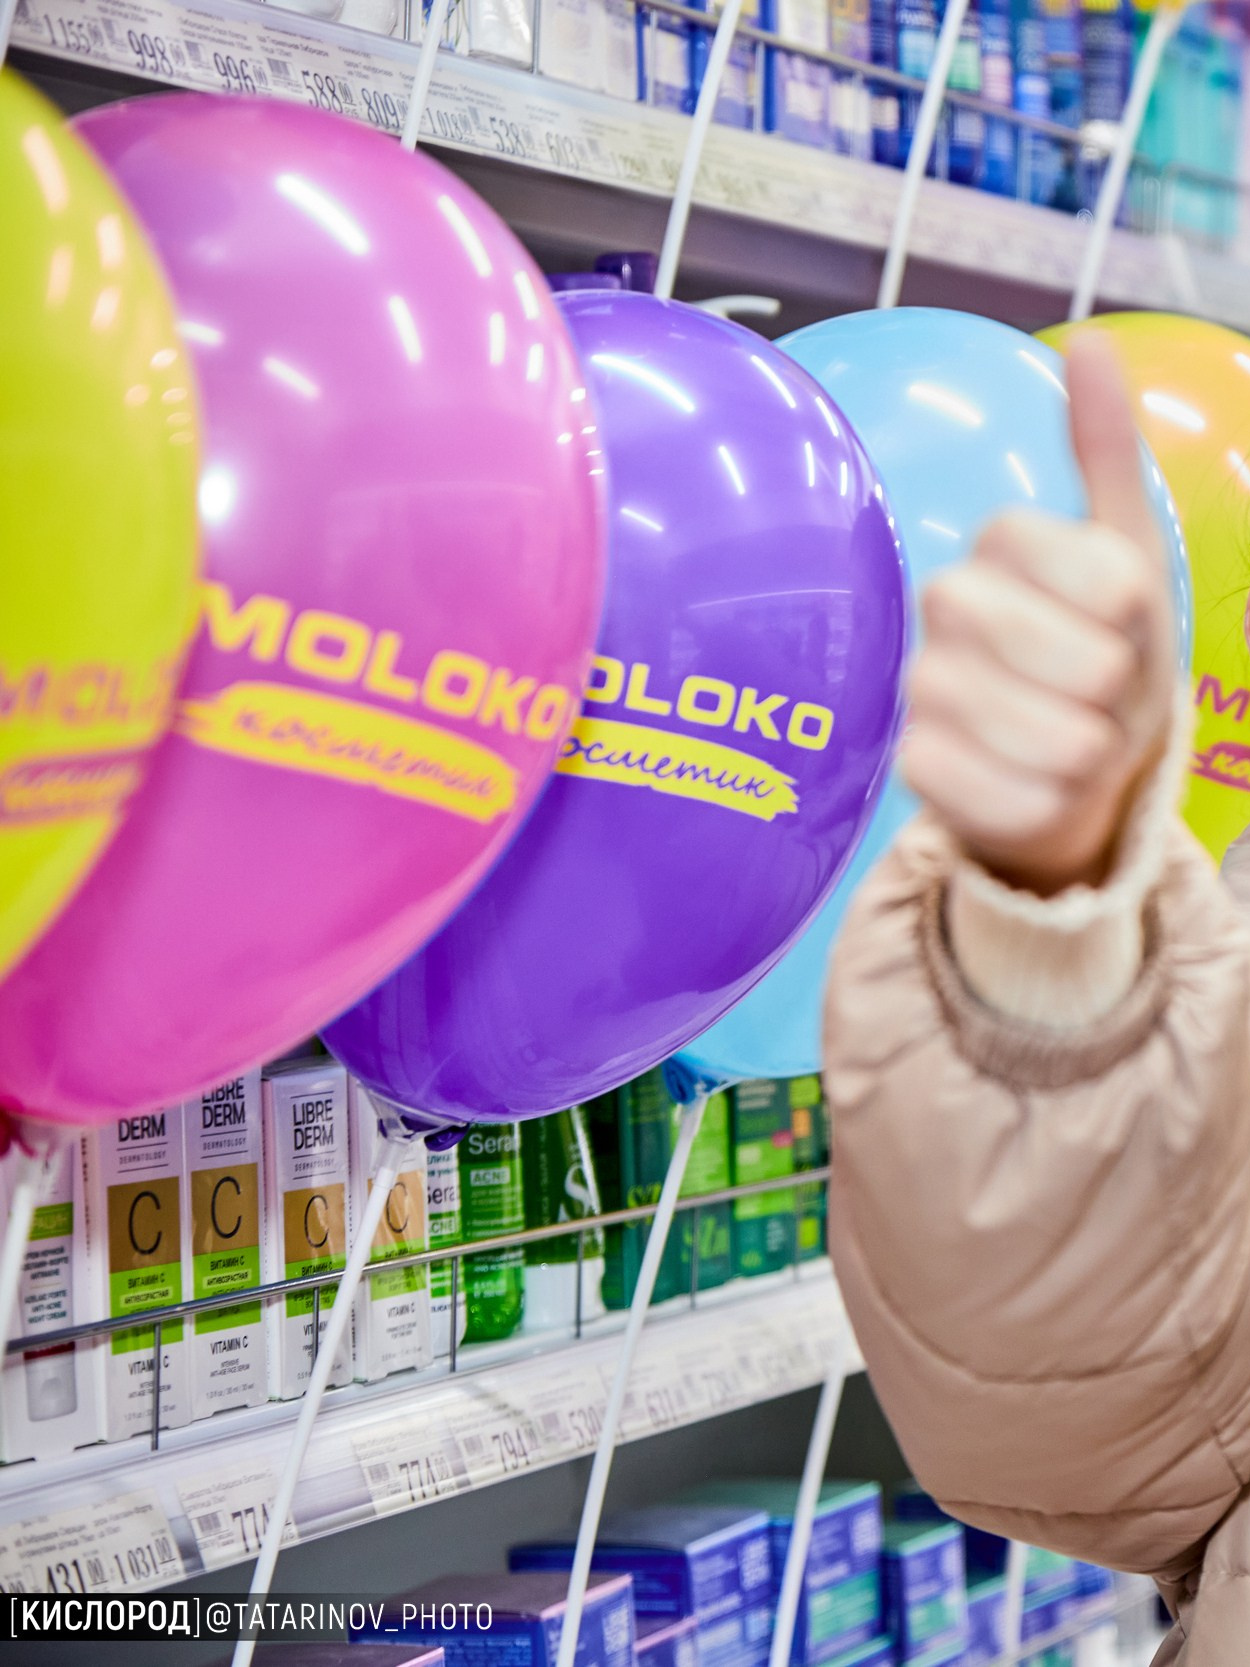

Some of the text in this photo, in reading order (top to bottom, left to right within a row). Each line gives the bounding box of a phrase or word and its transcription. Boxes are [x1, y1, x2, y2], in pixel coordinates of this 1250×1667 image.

[127, 29, 174, 77] 998
[213, 52, 257, 94] 996
[301, 69, 344, 114] 588
[361, 87, 401, 130] 809
[202, 581, 572, 740] MOLOKO
[582, 655, 835, 751] OLOKO
[560, 737, 776, 799] осметик
[117, 1112, 167, 1143] DERM
[202, 1101, 246, 1129] DERM
[292, 1099, 334, 1127] LIBRE
[118, 1150, 167, 1166] DERMATOLOGY
[202, 1136, 247, 1151] DERMATOLOGY
[294, 1123, 335, 1151] DERM
[128, 1190, 163, 1256] C
[211, 1175, 243, 1240] C
[304, 1194, 330, 1249] C
[386, 1181, 410, 1234] C
[127, 1276, 158, 1290] ВИТАМИН
[209, 1257, 239, 1272] ВИТАМИН
[387, 1304, 411, 1319] VITAMIN
[210, 1335, 249, 1356] VITAMIN C
[491, 1428, 531, 1473] 794
